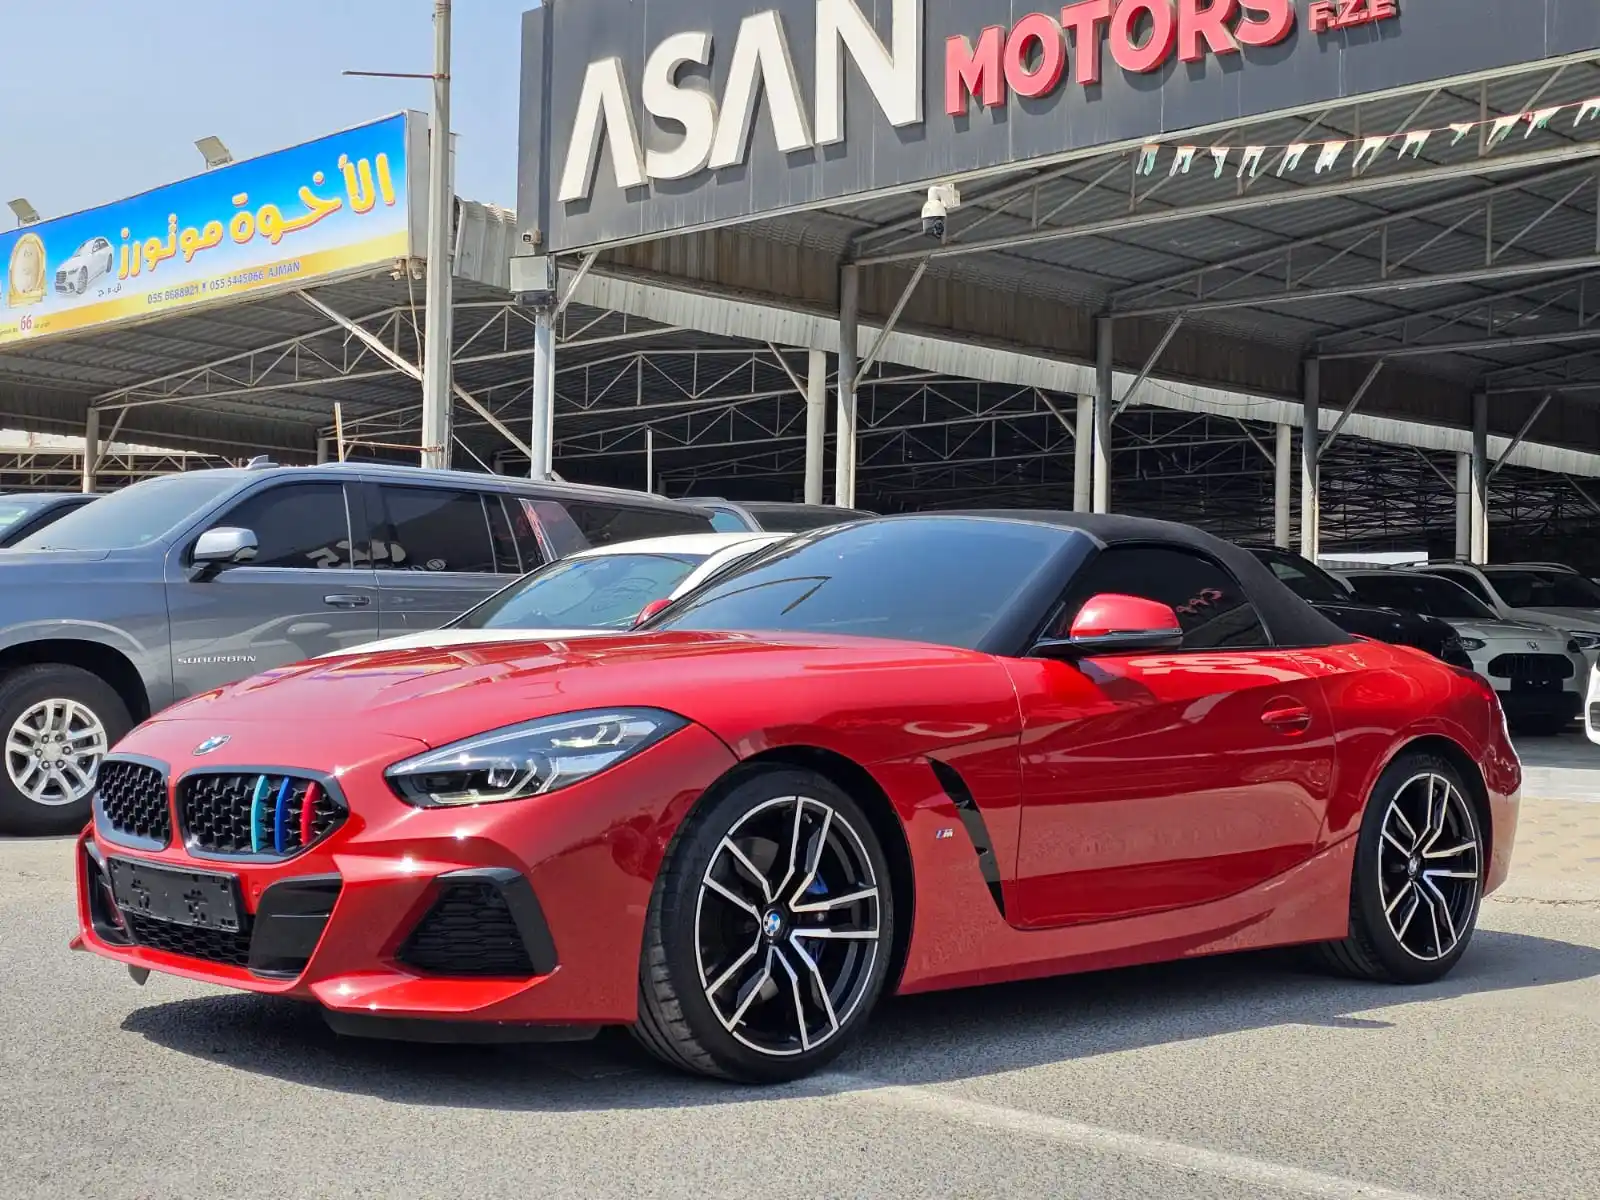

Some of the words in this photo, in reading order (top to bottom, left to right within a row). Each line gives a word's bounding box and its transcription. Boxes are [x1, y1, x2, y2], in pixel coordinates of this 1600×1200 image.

[558, 0, 923, 202] ASAN
[945, 0, 1294, 116] MOTORS
[230, 153, 395, 244] الأخوة
[118, 213, 223, 280] موتورز
[148, 291, 162, 304] 055
[210, 278, 225, 291] 055
[268, 261, 300, 277] AJMAN
[178, 655, 257, 664] SUBURBAN
